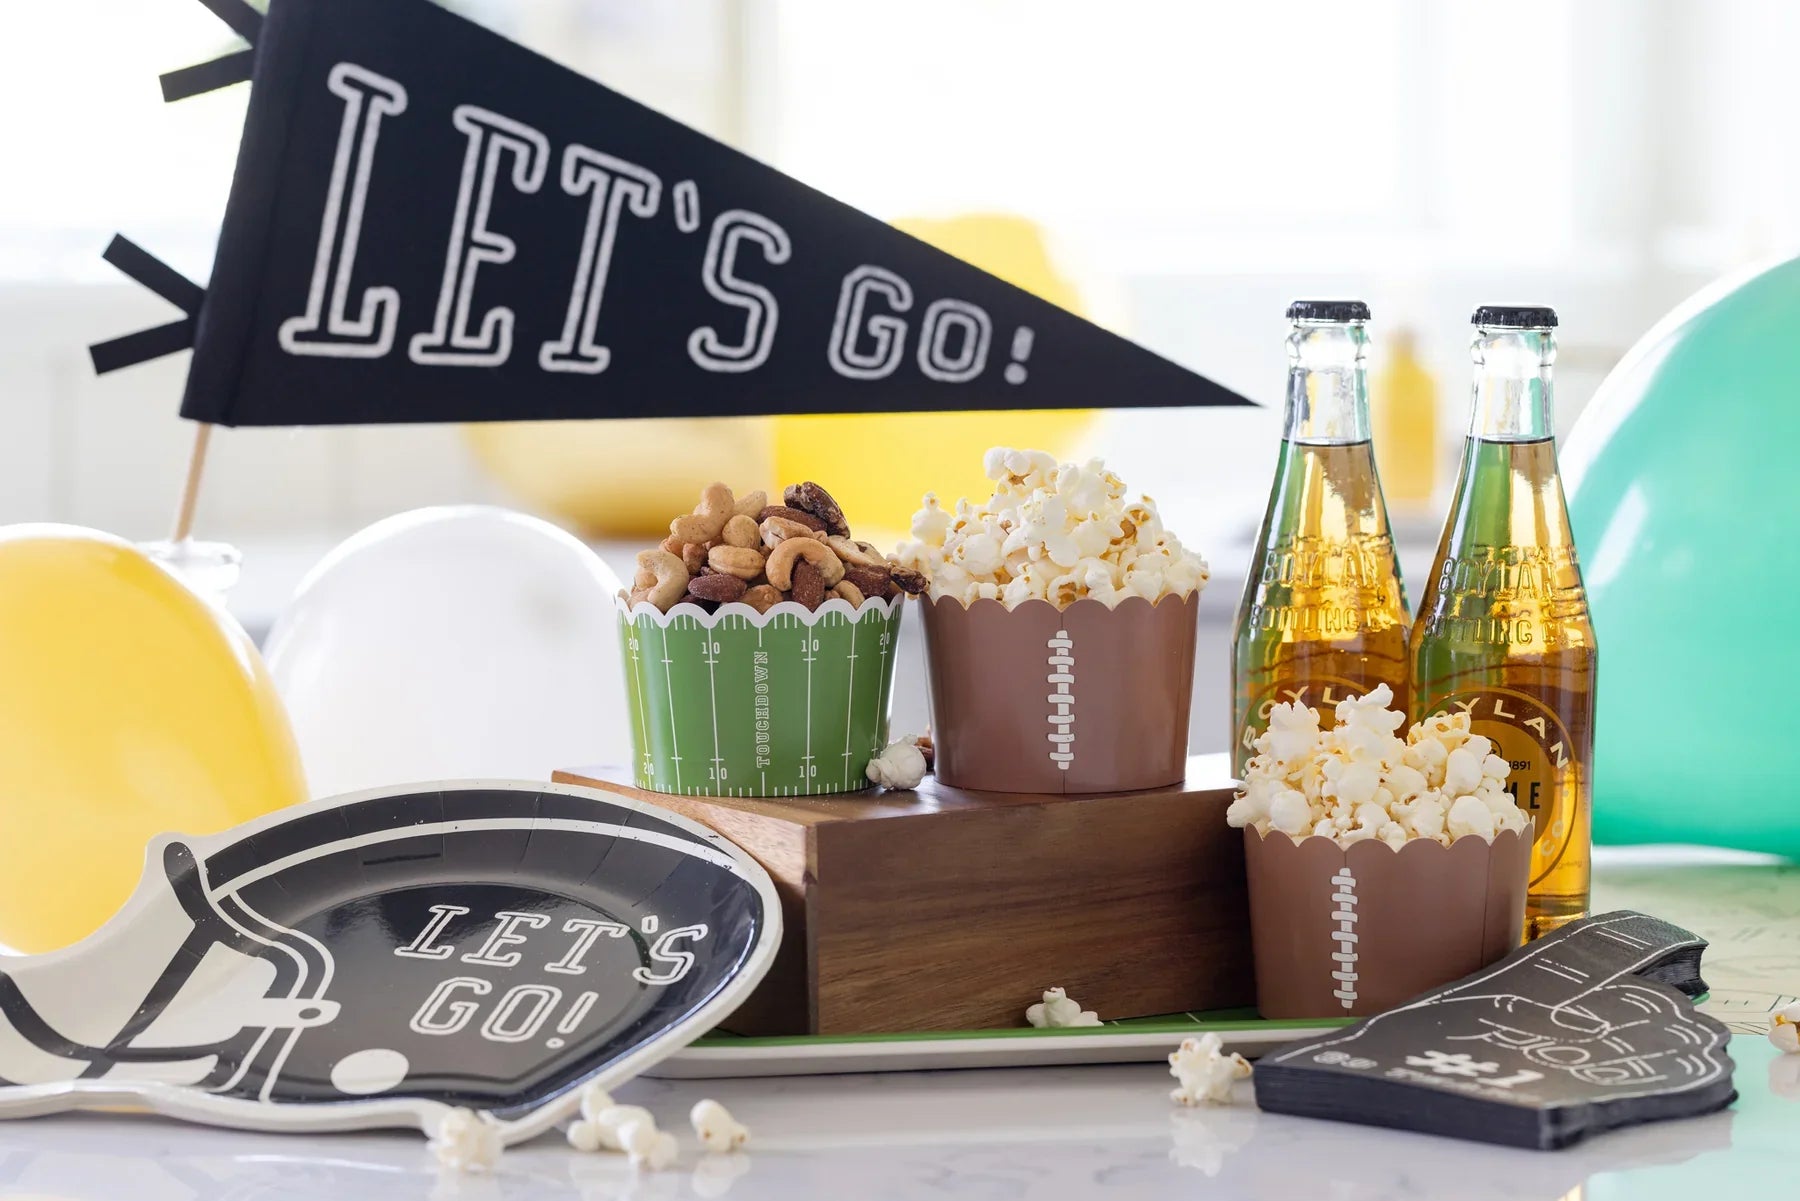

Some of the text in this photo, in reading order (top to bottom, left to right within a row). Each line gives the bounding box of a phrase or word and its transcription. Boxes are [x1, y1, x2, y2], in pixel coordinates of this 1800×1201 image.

[279, 62, 1034, 385] LET'S GO!
[702, 641, 721, 655] 10
[801, 639, 820, 652] 10
[754, 651, 771, 768] TOUCHDOWN
[1242, 685, 1341, 749] BOYL
[709, 767, 728, 780] 10
[799, 765, 817, 778] 10
[394, 904, 709, 985] LET'S
[409, 976, 600, 1049] GO!
